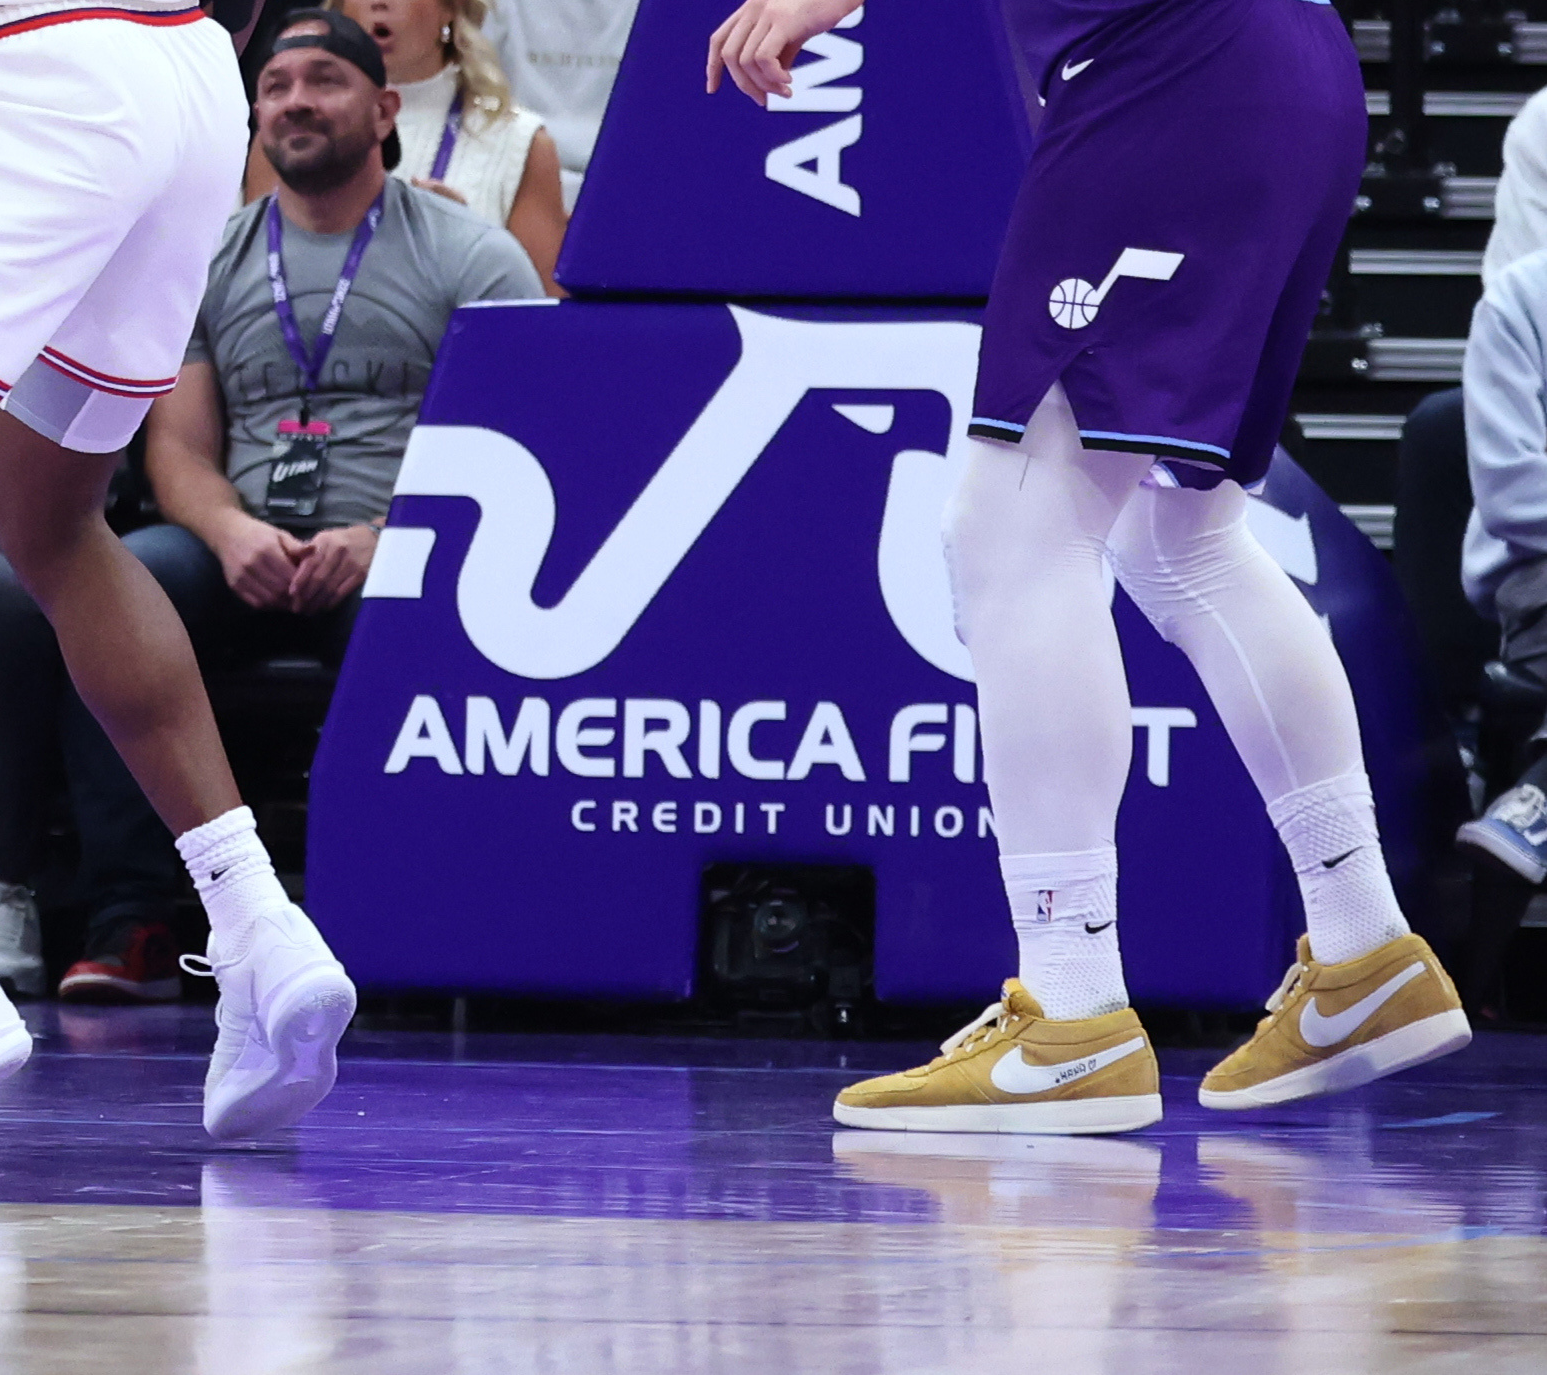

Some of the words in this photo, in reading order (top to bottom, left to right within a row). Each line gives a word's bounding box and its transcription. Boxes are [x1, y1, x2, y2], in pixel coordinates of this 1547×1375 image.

[273, 459, 319, 483] UTAH
[385, 695, 866, 781] AMERICA
[888, 702, 1198, 788] FIT
[570, 799, 786, 835] CREDIT
[824, 802, 997, 839] UNION
